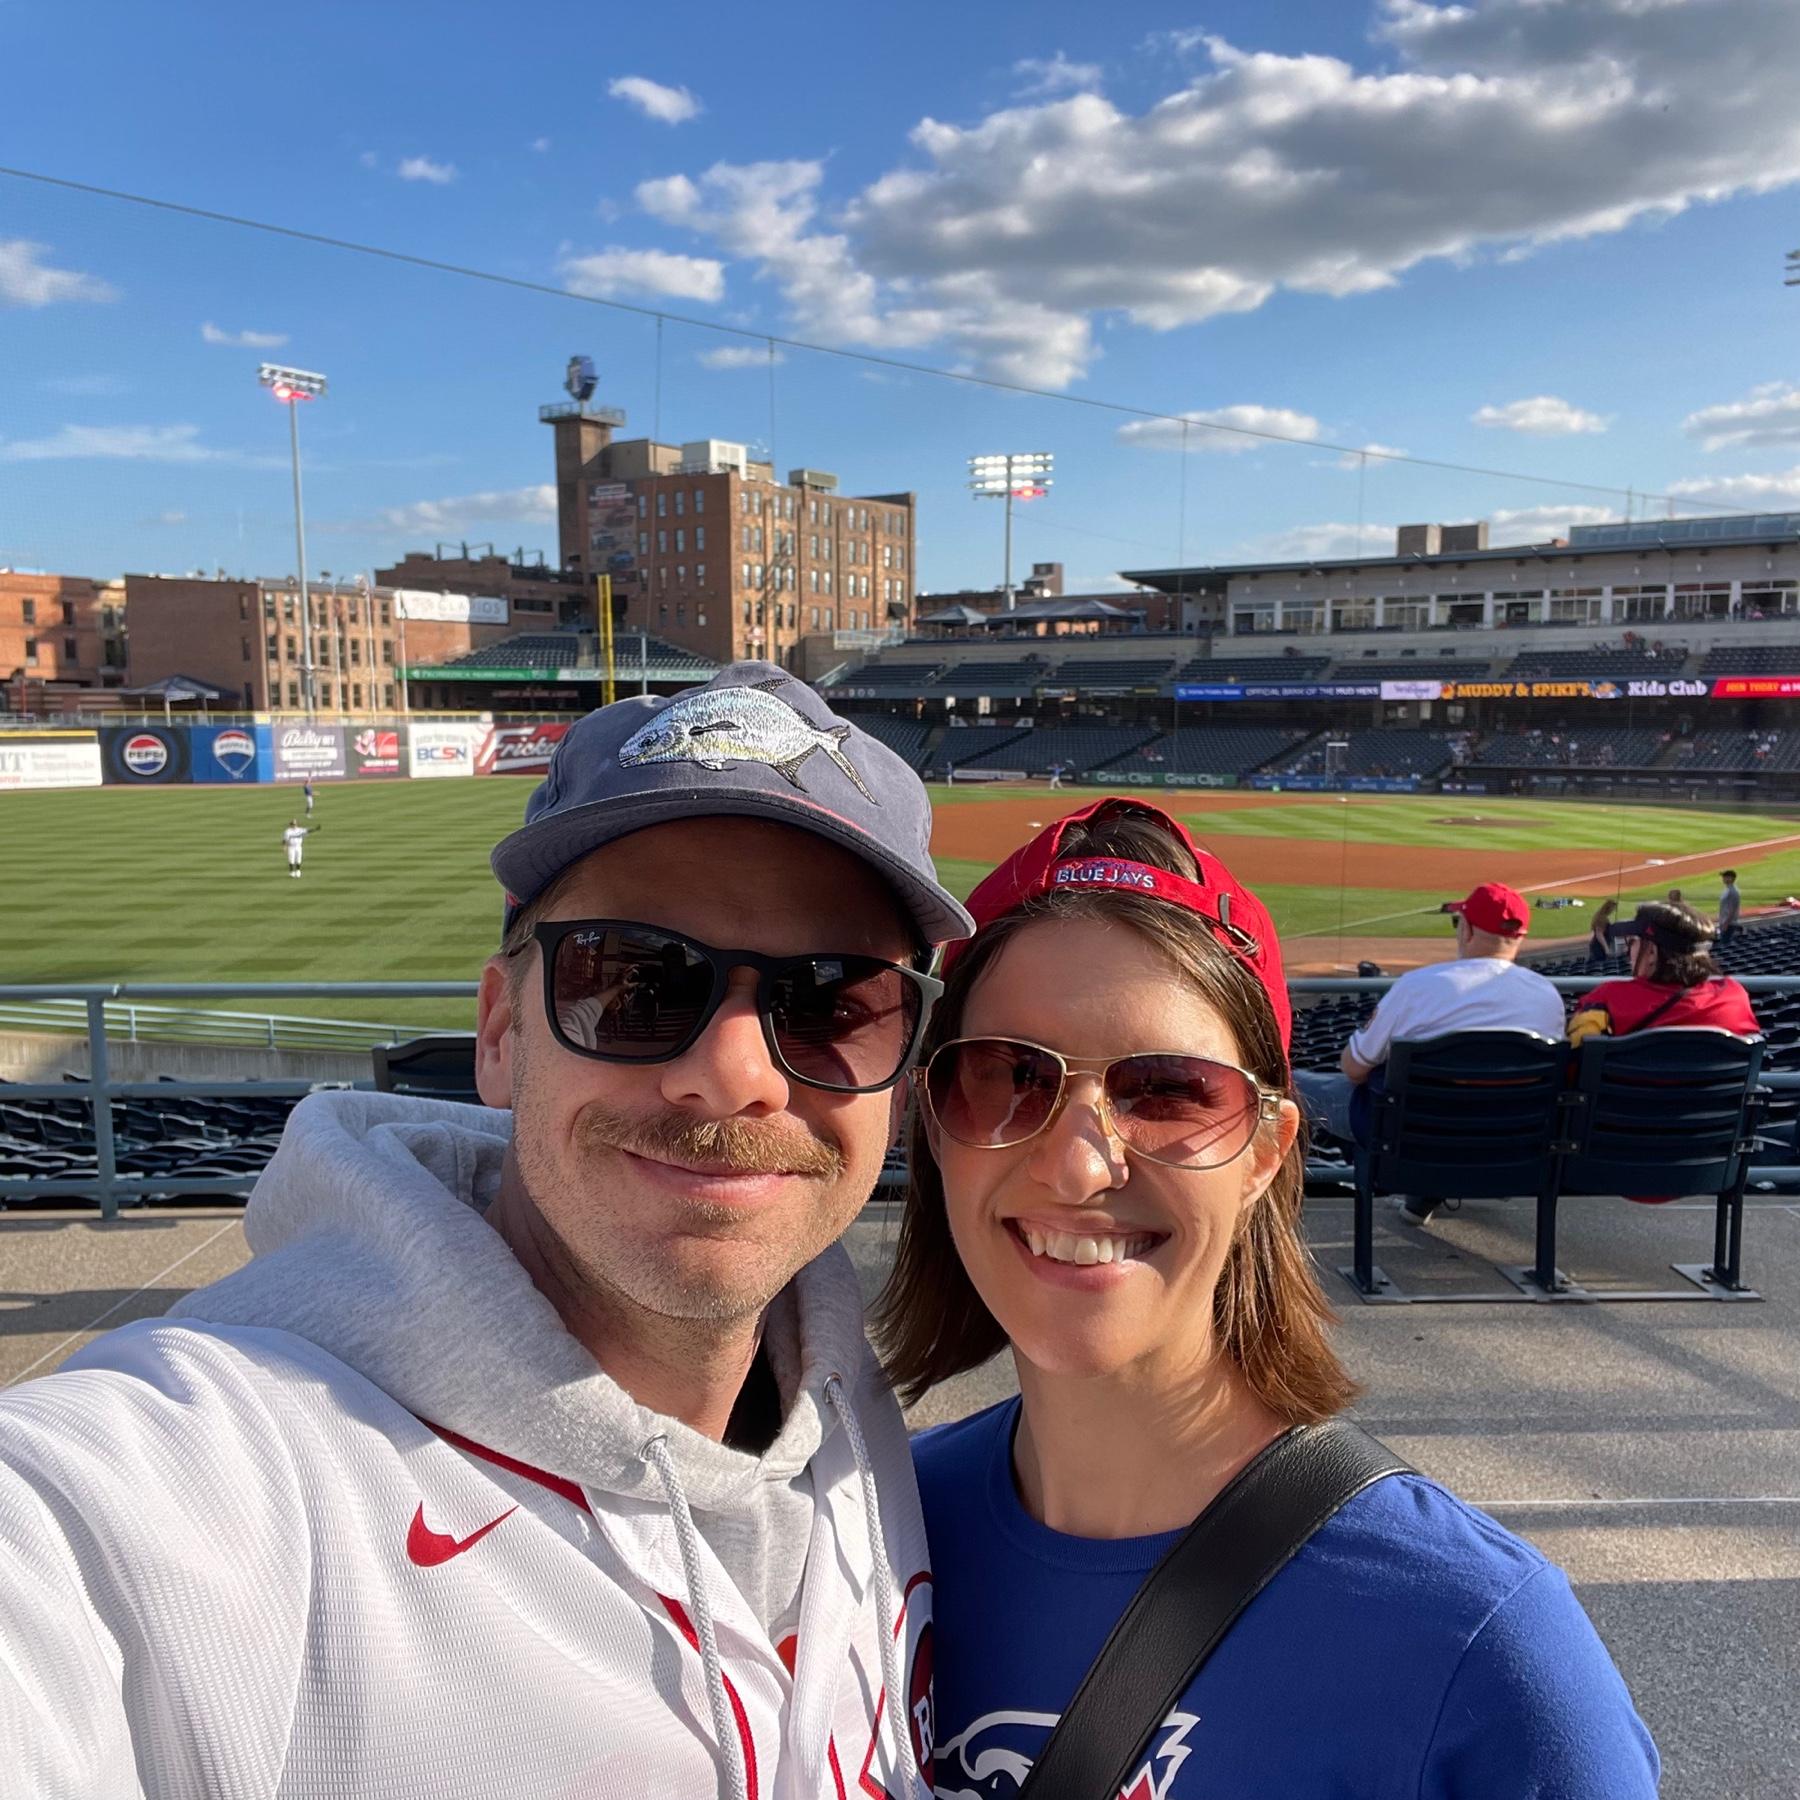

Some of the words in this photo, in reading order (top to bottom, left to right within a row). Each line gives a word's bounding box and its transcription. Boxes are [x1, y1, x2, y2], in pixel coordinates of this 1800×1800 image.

[1457, 684, 1513, 697] MUDDY
[1515, 682, 1529, 697] &
[1627, 681, 1666, 697] Kids
[1668, 681, 1708, 697] Club
[128, 751, 164, 760] PEPSI
[416, 745, 467, 761] BCSN
[1096, 771, 1127, 783] Great
[1128, 772, 1153, 785] Clips
[1164, 772, 1197, 785] Great
[1197, 773, 1225, 787] Clips
[1056, 868, 1105, 883] BLUE
[1105, 868, 1155, 889] JAYS
